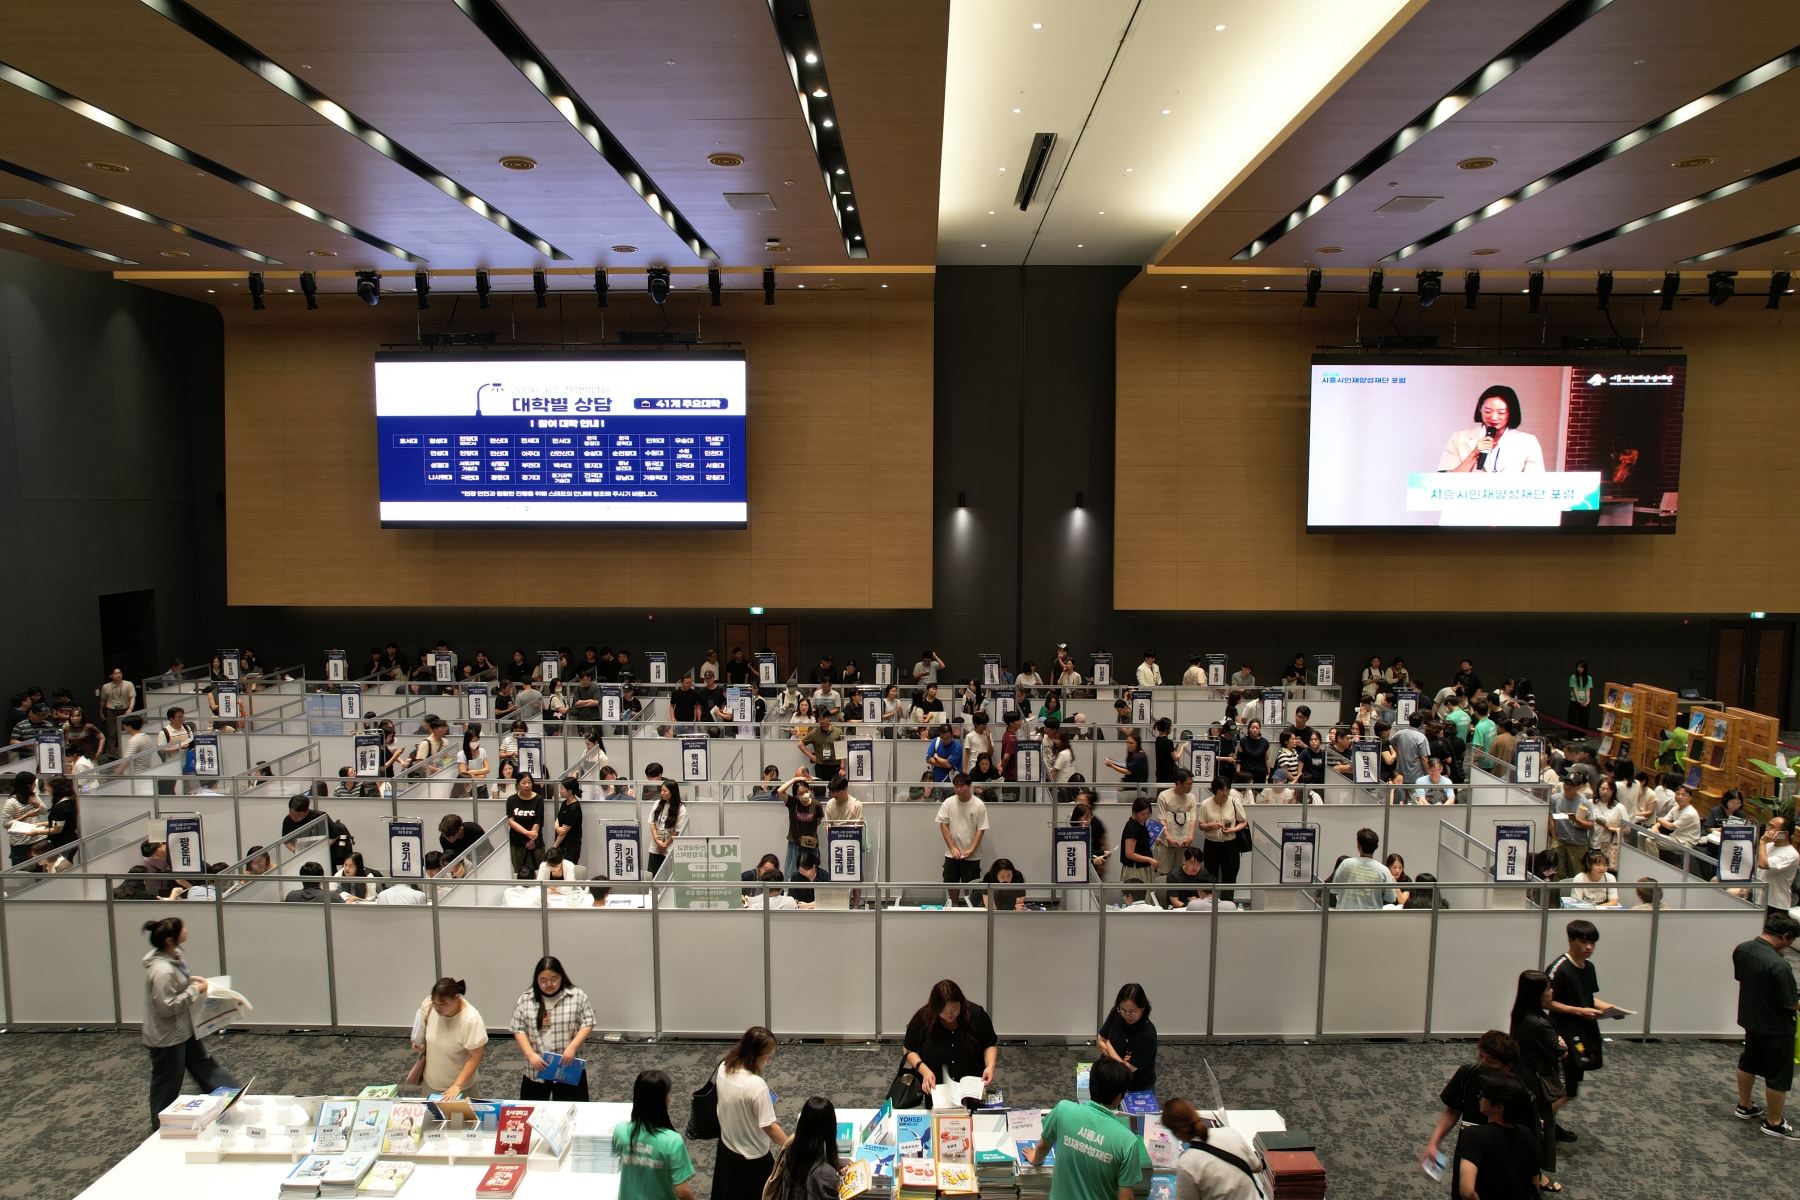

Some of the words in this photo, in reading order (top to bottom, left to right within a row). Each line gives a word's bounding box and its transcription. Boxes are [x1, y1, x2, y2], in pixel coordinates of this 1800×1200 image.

[512, 397, 568, 412] 대학별
[574, 397, 613, 412] 상담
[656, 399, 681, 408] 41개
[1431, 489, 1546, 500] 시흥시인재양성재단
[1551, 489, 1575, 500] 포럼
[179, 837, 190, 866] 광운대
[402, 842, 411, 871] 경기대
[615, 843, 623, 876] 경기과학
[626, 848, 634, 872] 기술대
[835, 847, 843, 874] 건국대
[847, 845, 855, 875] (글로컬)
[1067, 847, 1076, 876] 강남대
[1507, 846, 1516, 875] 가천대
[1731, 846, 1743, 874] 강원대
[392, 1106, 424, 1117] KNU
[1063, 1135, 1114, 1164] 인재양성재단
[1077, 1127, 1105, 1146] 시흥시
